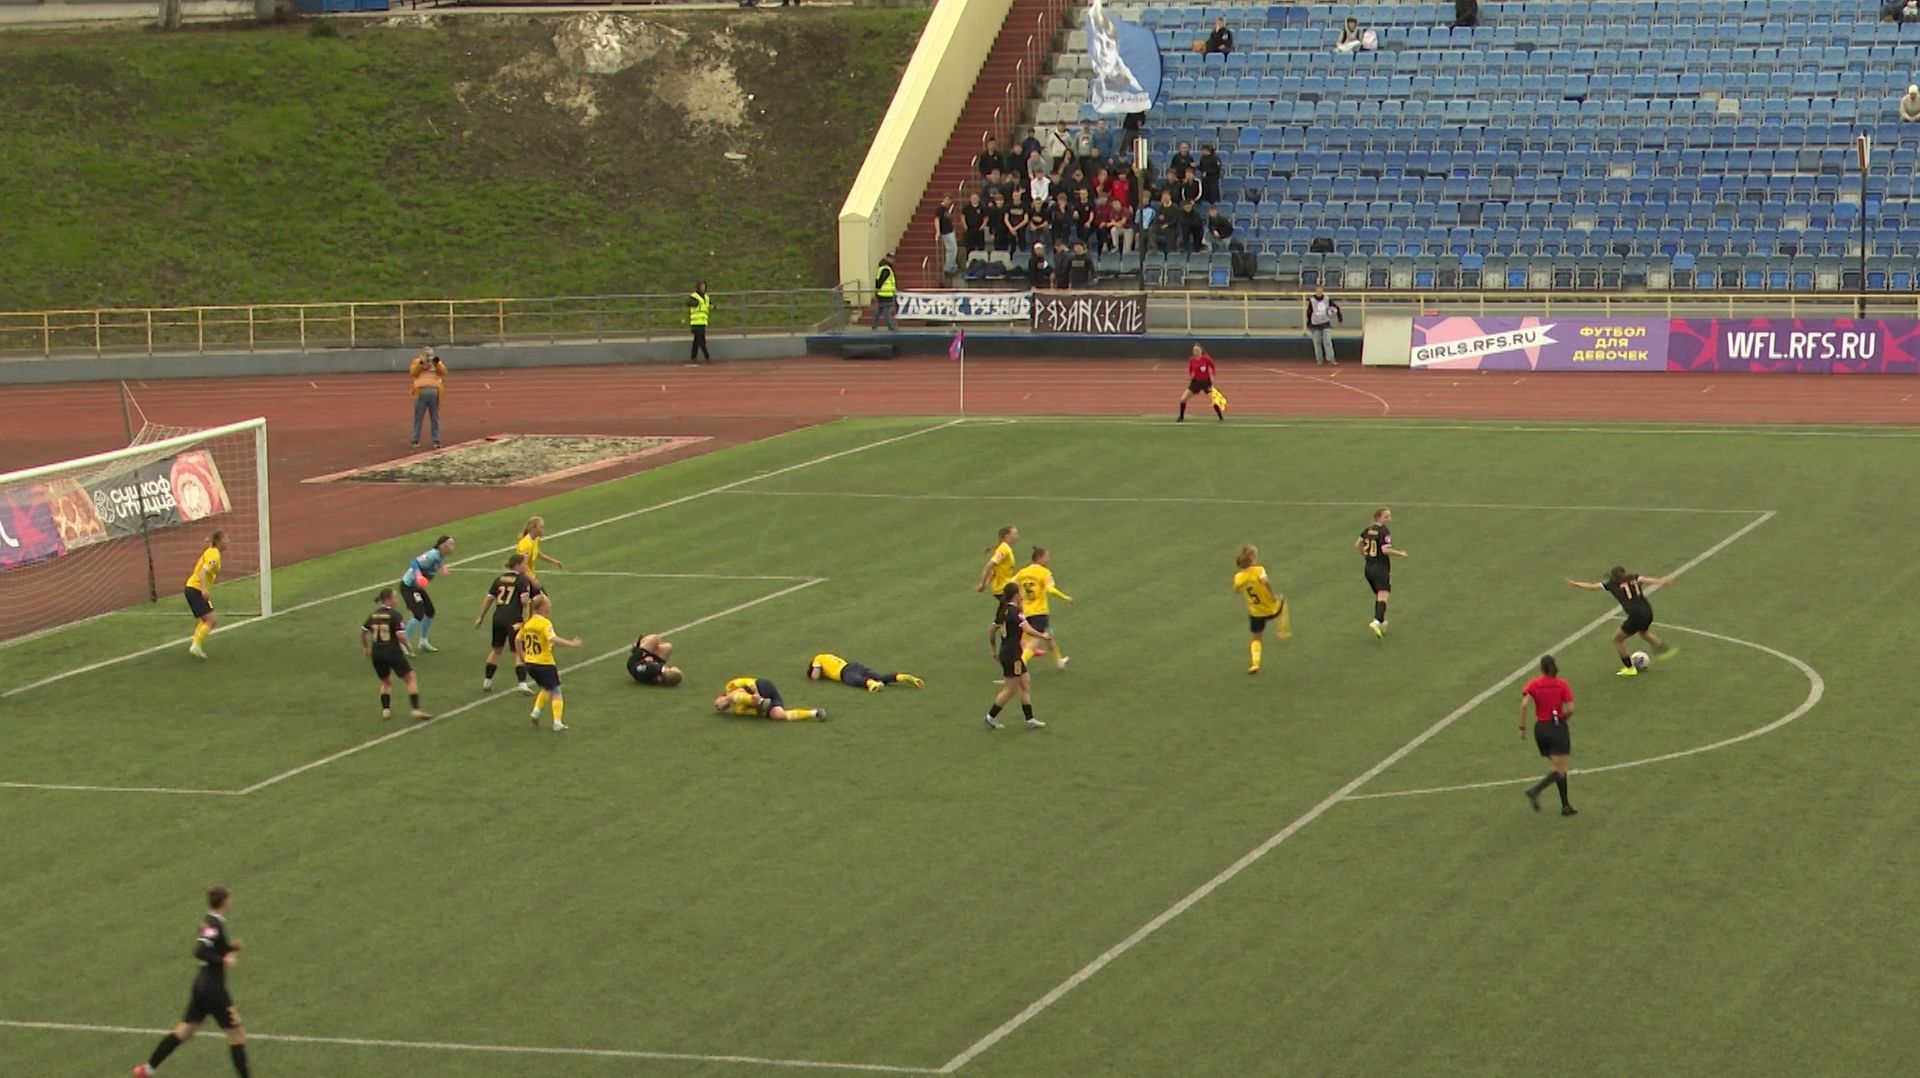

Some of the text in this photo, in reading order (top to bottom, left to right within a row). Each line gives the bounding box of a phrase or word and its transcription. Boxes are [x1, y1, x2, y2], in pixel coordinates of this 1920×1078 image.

[1579, 326, 1647, 338] ФУТБОЛ
[1416, 331, 1536, 361] GIRLS.RFS.RU
[1595, 338, 1629, 349] ДЛЯ
[1727, 332, 1876, 359] WFL.RFS.RU
[1572, 349, 1648, 362] ДЕВОЧЕК
[497, 586, 515, 605] 27
[1247, 586, 1261, 605] 5
[525, 634, 542, 655] 26
